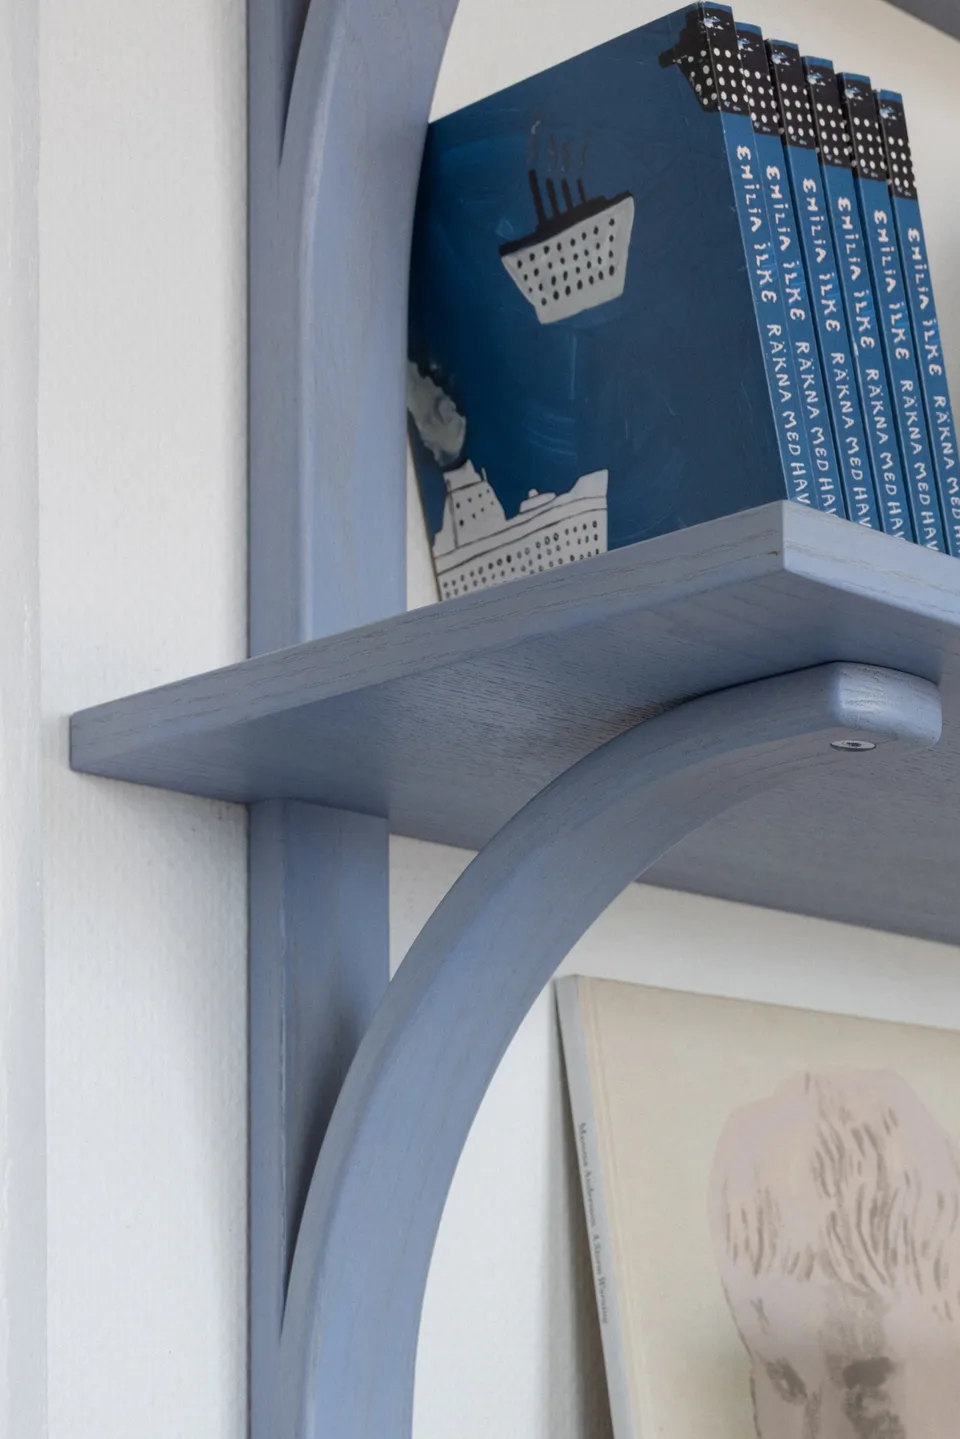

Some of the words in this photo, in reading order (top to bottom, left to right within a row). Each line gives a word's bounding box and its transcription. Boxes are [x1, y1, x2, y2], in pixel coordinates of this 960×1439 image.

[766, 324, 792, 403] RÄKNA
[830, 352, 855, 429] RÄKNA
[781, 410, 802, 456] MED
[795, 341, 821, 419] RÄKNA
[810, 426, 829, 472] MED
[865, 368, 889, 445] RÄKNA
[879, 451, 897, 496] MED
[900, 379, 923, 455] RÄKNA
[933, 394, 958, 471] RÄKNA
[789, 461, 812, 506] HAV
[845, 436, 864, 481] MED
[913, 462, 931, 506] MED
[852, 486, 873, 530] HAV
[920, 510, 940, 552] HAV
